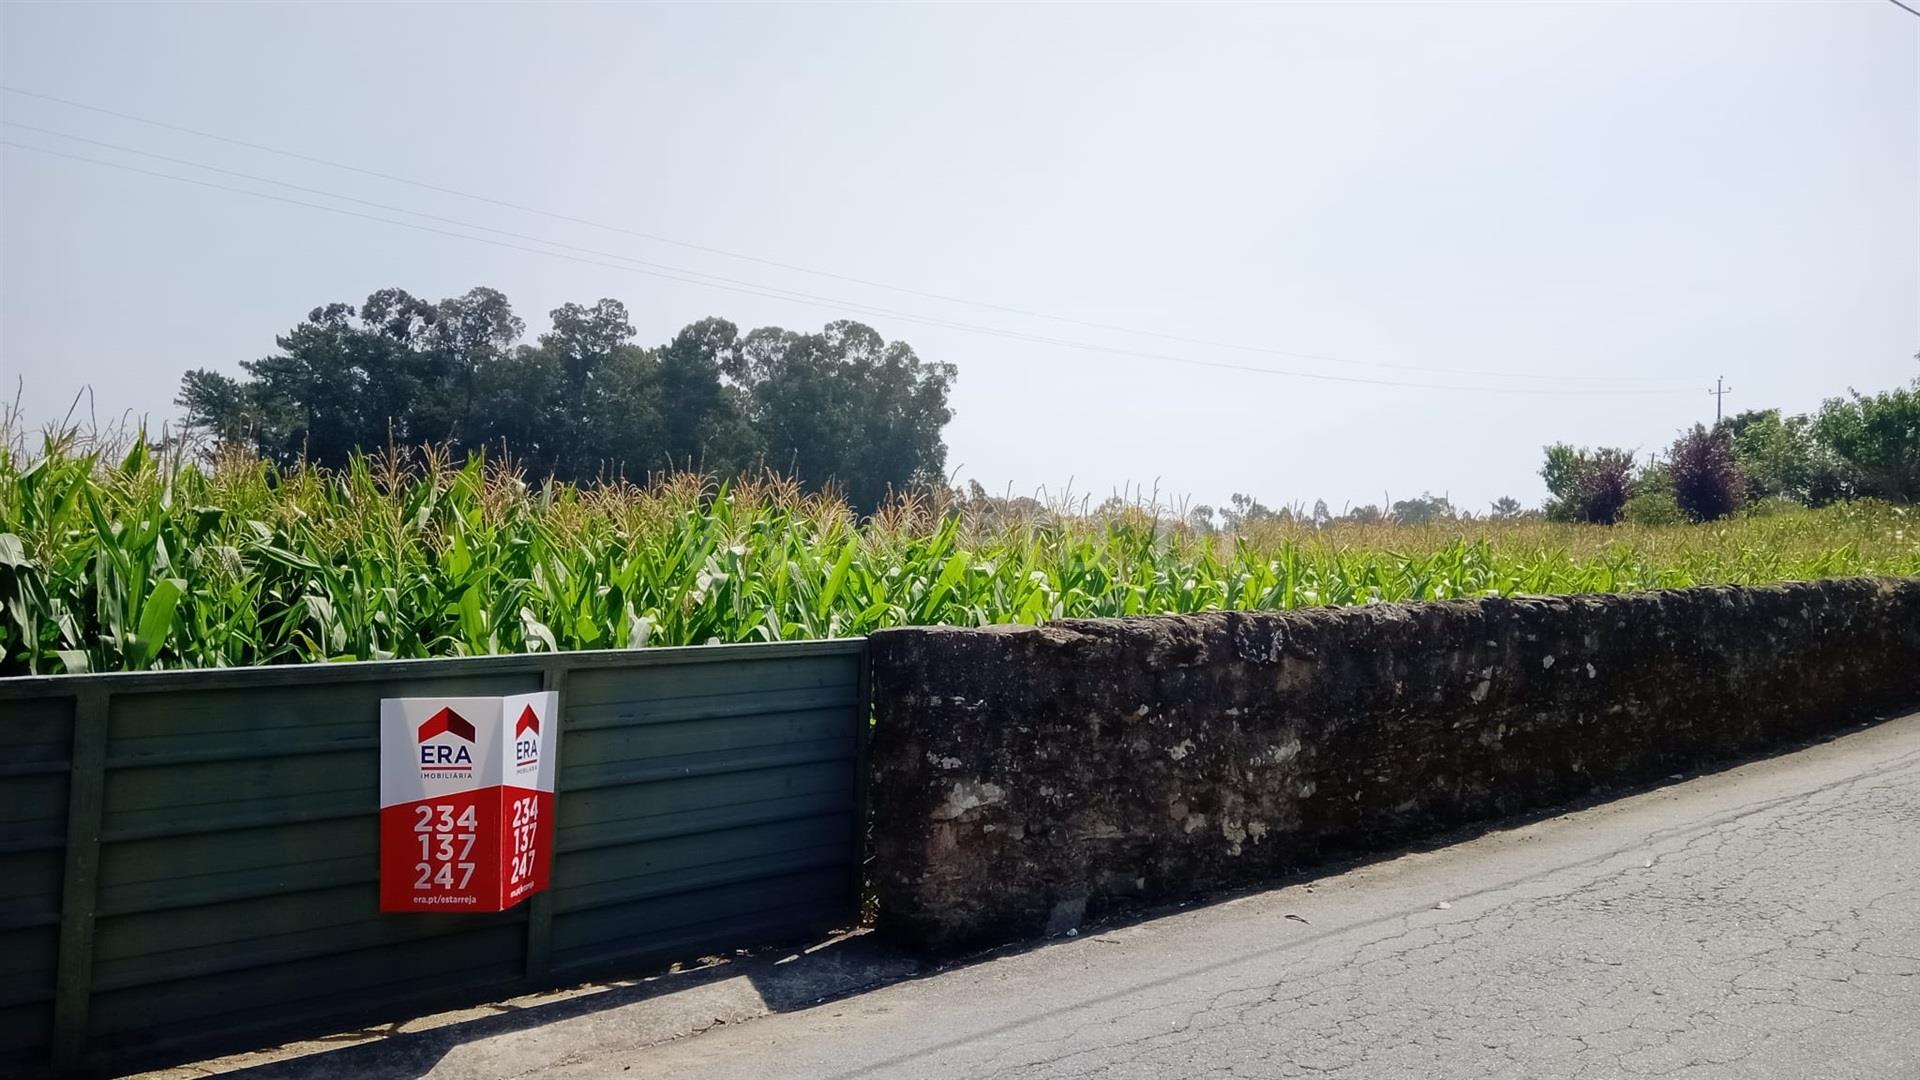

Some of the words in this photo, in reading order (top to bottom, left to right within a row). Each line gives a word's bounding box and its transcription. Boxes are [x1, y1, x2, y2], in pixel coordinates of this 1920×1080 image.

[421, 745, 472, 764] ERA
[516, 739, 538, 760] ERA
[414, 805, 478, 832] 234
[512, 795, 538, 828] 234
[418, 834, 476, 861] 137
[513, 822, 537, 855] 137
[414, 863, 476, 890] 247
[510, 849, 536, 885] 247
[413, 894, 477, 905] era.pt/estarreja
